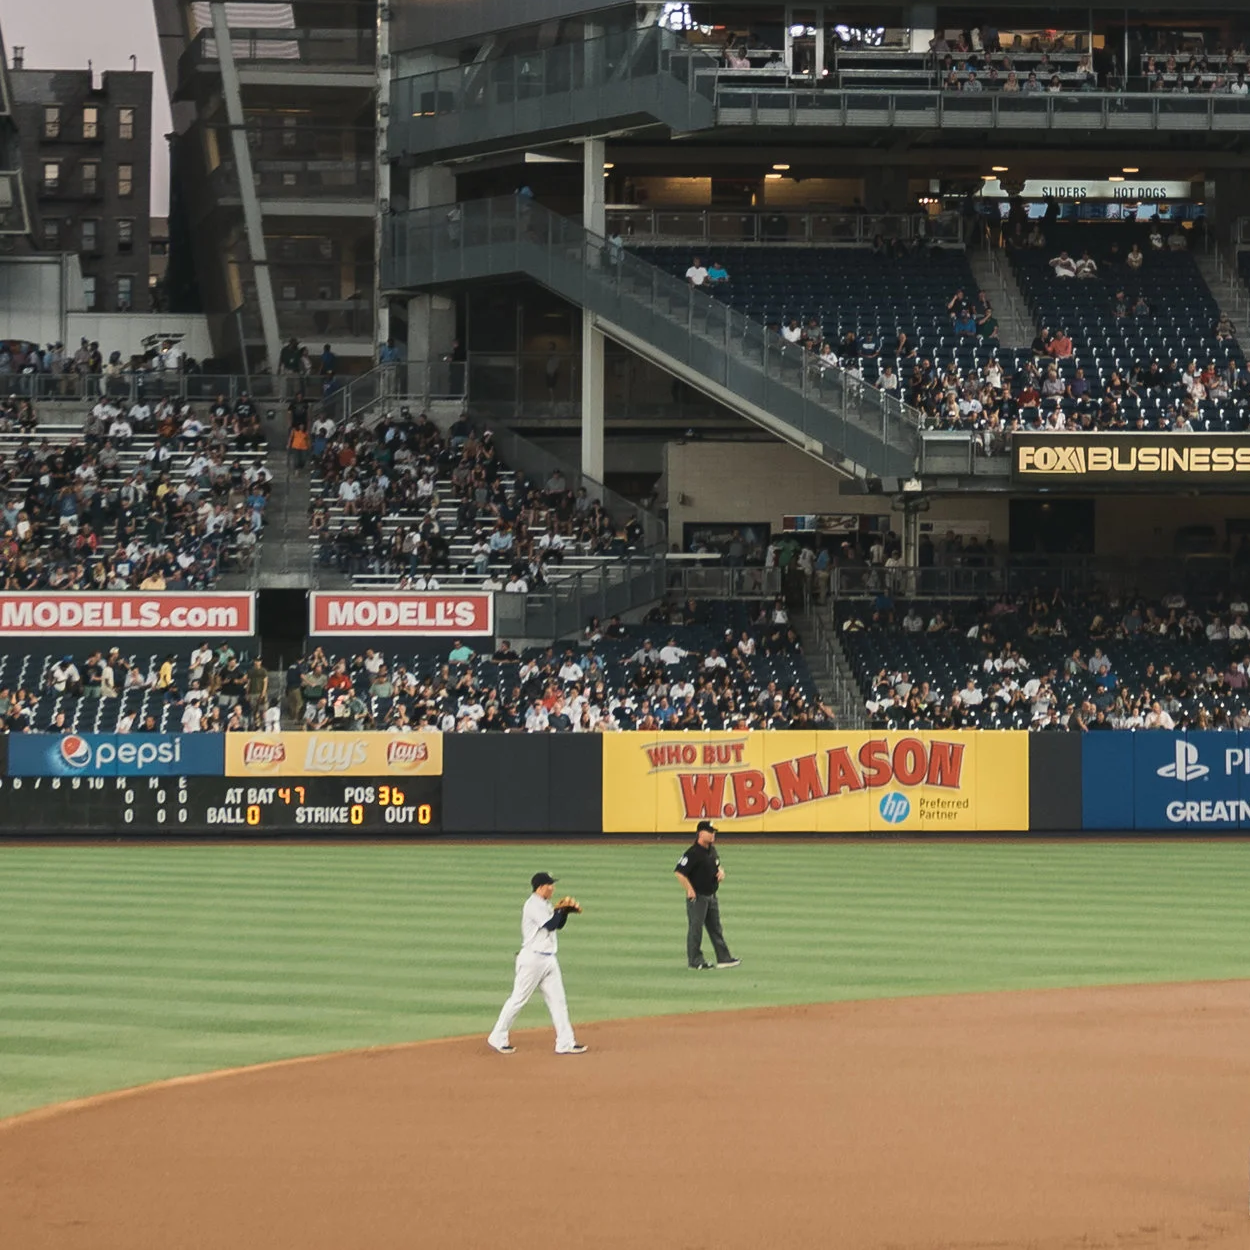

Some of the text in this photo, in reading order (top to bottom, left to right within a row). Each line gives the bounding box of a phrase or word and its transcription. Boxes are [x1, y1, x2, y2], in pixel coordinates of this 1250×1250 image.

[1042, 186, 1087, 198] SLIDERS
[1113, 187, 1166, 198] HOT DOGS
[1019, 446, 1077, 473] FOX
[1, 601, 238, 628] MODELLS.com
[327, 600, 475, 627] MODELL'S
[96, 738, 181, 769] pepsi
[303, 736, 369, 772] Lay's
[647, 743, 745, 768] WHO BUT
[124, 789, 188, 804] 0 0 0
[225, 787, 244, 804] AT
[247, 787, 276, 804] BAT
[344, 787, 375, 804] POS
[919, 797, 969, 810] Preferred
[124, 808, 188, 823] 0 0 0
[206, 804, 431, 825] BALL 0 STRIKE 0 OUT 0
[883, 794, 910, 823] hp
[919, 810, 958, 820] Partner
